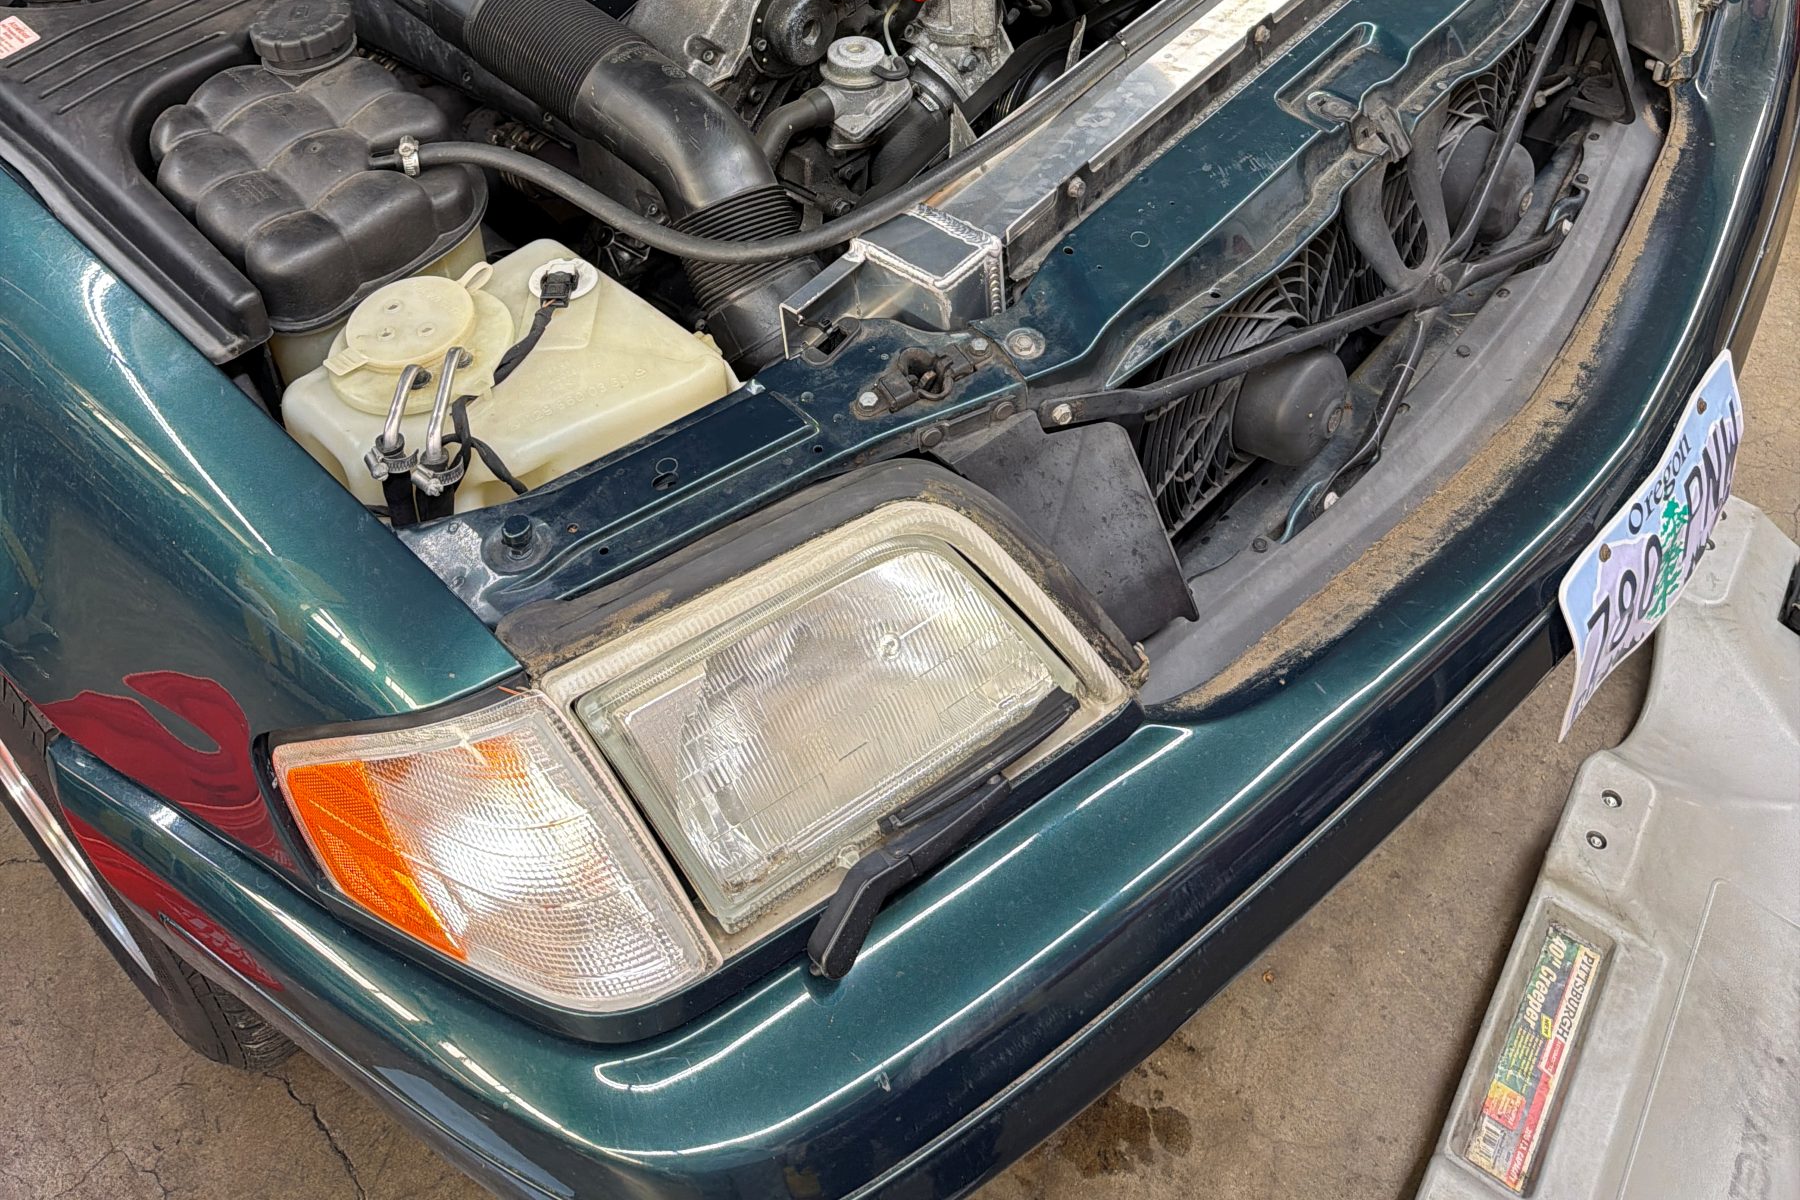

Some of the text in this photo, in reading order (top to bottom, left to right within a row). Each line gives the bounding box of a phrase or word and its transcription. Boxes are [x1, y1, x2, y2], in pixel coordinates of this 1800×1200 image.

[1627, 433, 1692, 536] Oregon
[1681, 398, 1739, 563] PNW
[1523, 965, 1557, 1030] Creeper
[1549, 935, 1567, 969] 40"
[1557, 951, 1595, 1042] PITTSBURGH
